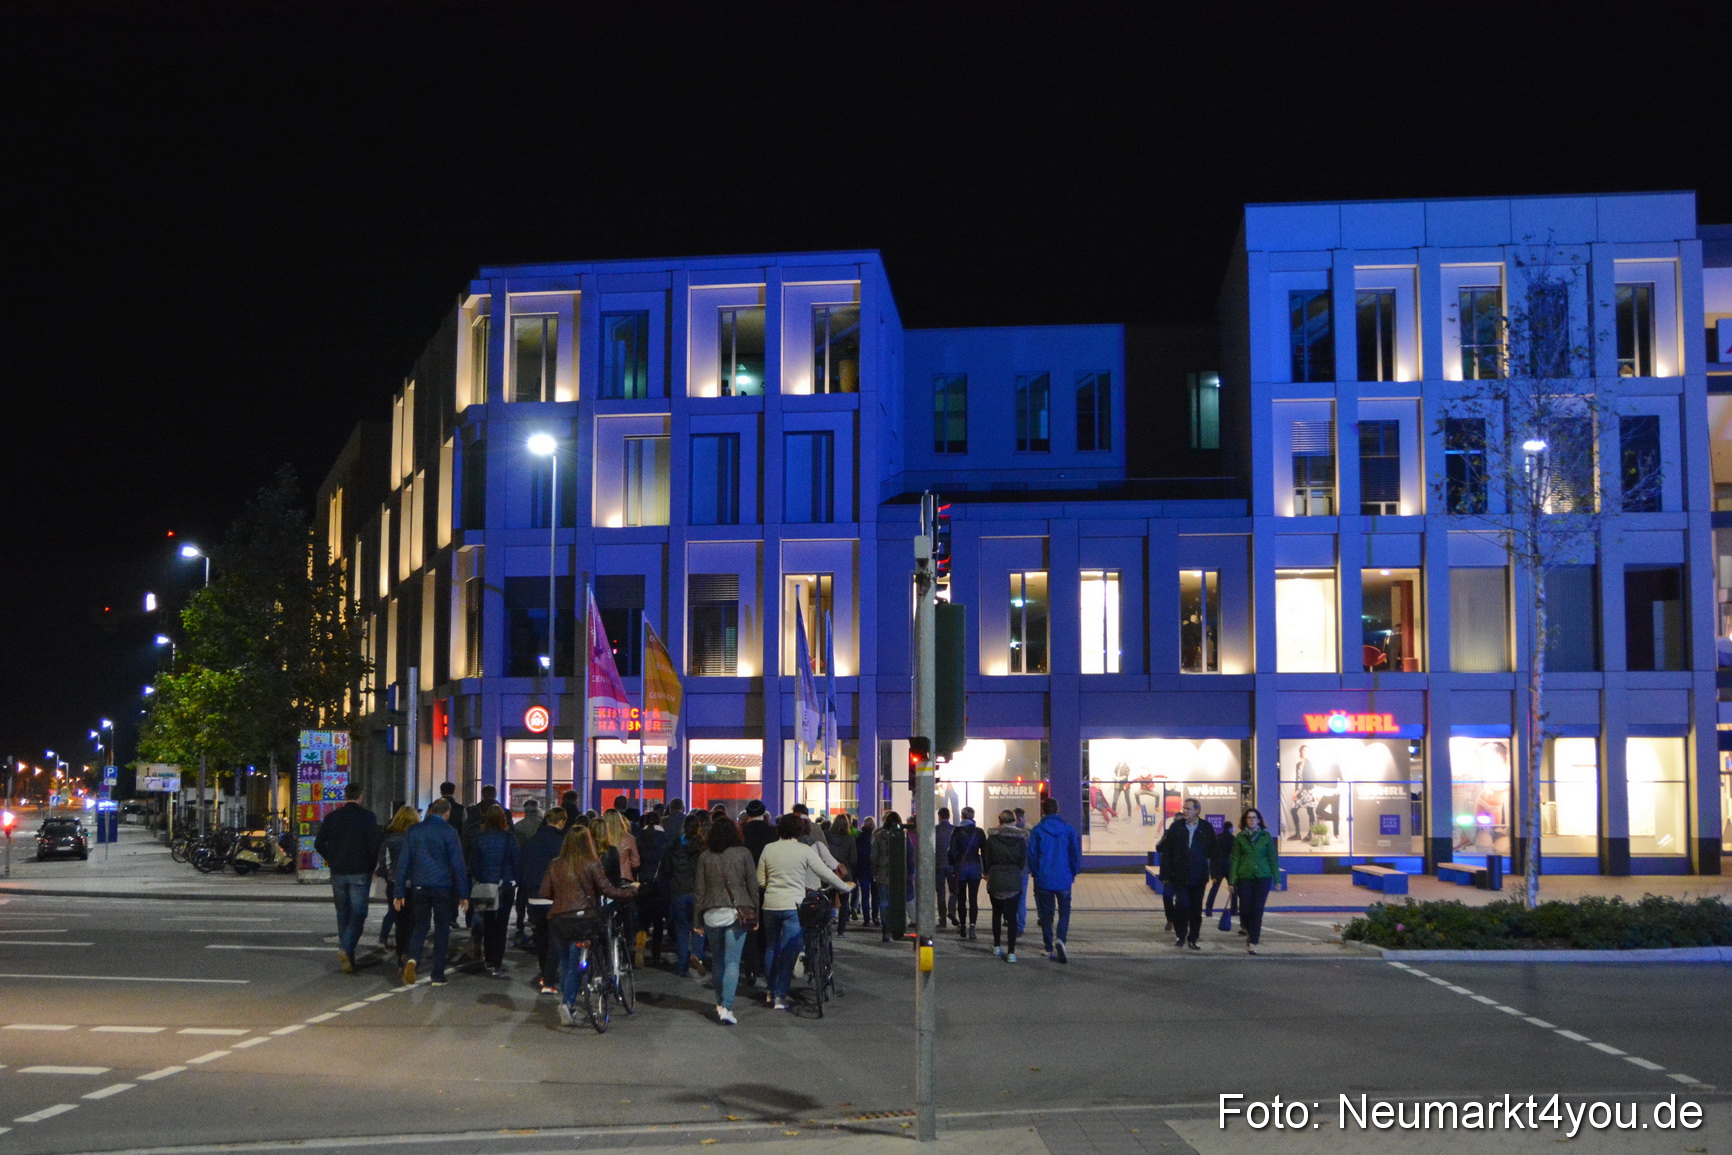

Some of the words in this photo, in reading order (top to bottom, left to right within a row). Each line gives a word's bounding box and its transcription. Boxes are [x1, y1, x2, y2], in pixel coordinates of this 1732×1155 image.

[1303, 710, 1400, 733] WÖHRL
[987, 784, 1036, 795] WÖHRL
[1187, 784, 1237, 796] WÖHRL
